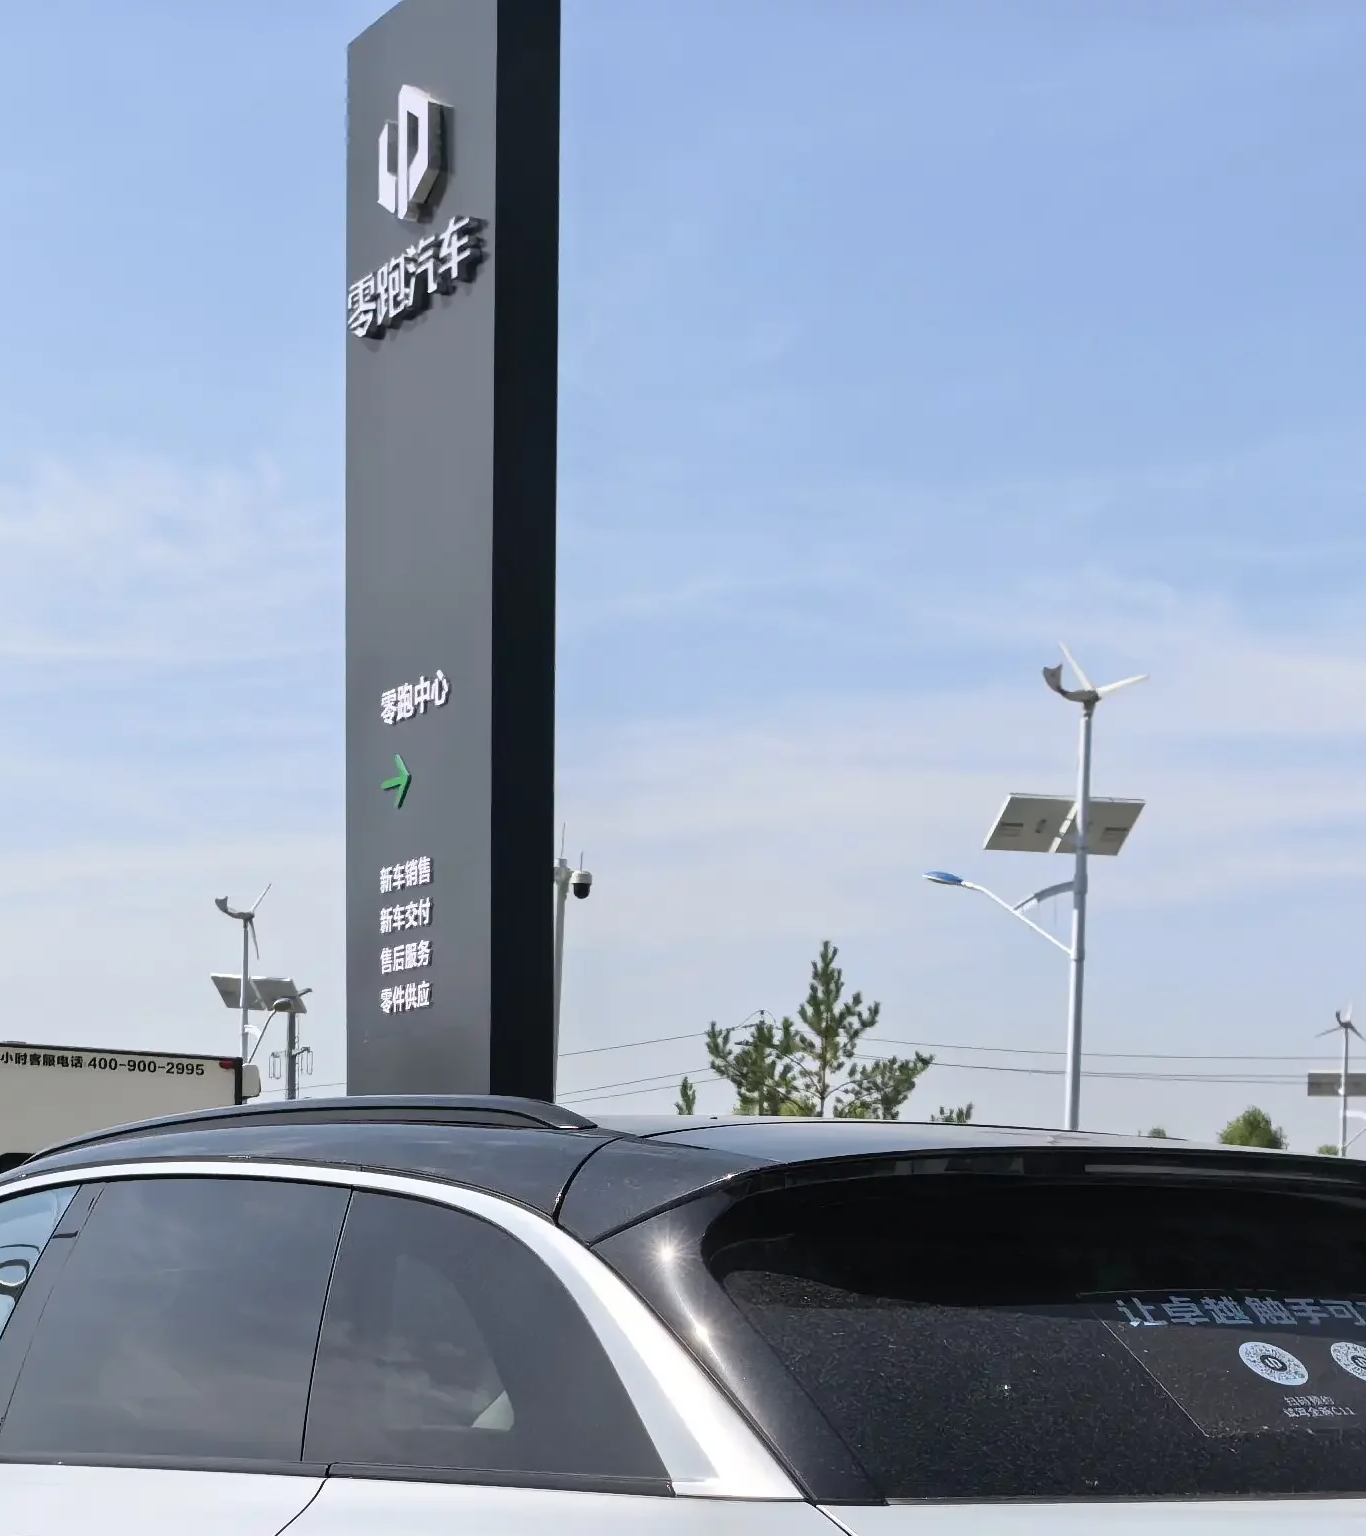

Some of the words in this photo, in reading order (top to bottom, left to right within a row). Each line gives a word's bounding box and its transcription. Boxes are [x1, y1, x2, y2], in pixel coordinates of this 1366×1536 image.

[347, 215, 471, 338] 零跑汽车
[380, 669, 449, 725] 零跑中心
[379, 856, 431, 894] 新车销售
[379, 897, 431, 934] 新车交付
[379, 940, 431, 975] 售后服务
[379, 981, 430, 1014] 零件供应
[87, 1056, 206, 1077] 400-900-2995
